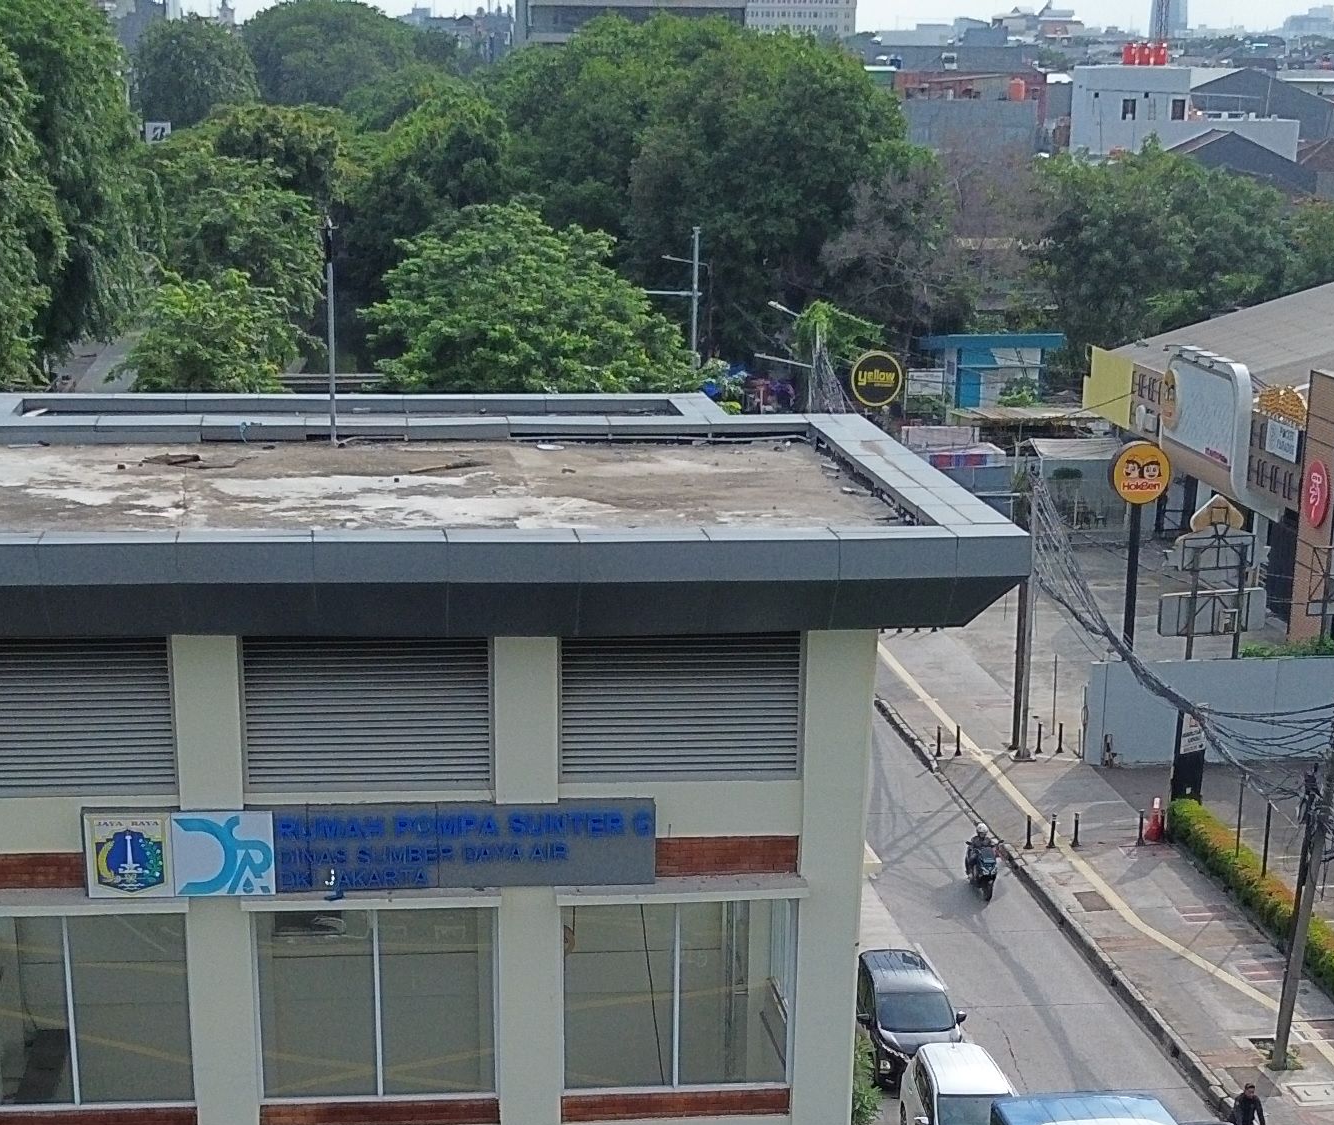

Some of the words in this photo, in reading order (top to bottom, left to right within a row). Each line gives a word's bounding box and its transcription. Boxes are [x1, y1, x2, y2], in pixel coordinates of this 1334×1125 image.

[858, 369, 895, 386] yellow
[1122, 481, 1160, 491] HokBen
[95, 820, 124, 828] JAYA
[130, 819, 160, 827] RAYA
[279, 814, 386, 840] RUMAH
[394, 813, 499, 838] POMPA
[508, 810, 626, 837] SUNTER
[281, 845, 347, 866] DINAS
[356, 843, 453, 865] SUMBER
[464, 841, 524, 864] DAYA
[530, 840, 569, 862] AIR
[324, 868, 430, 888] JAKARTA
